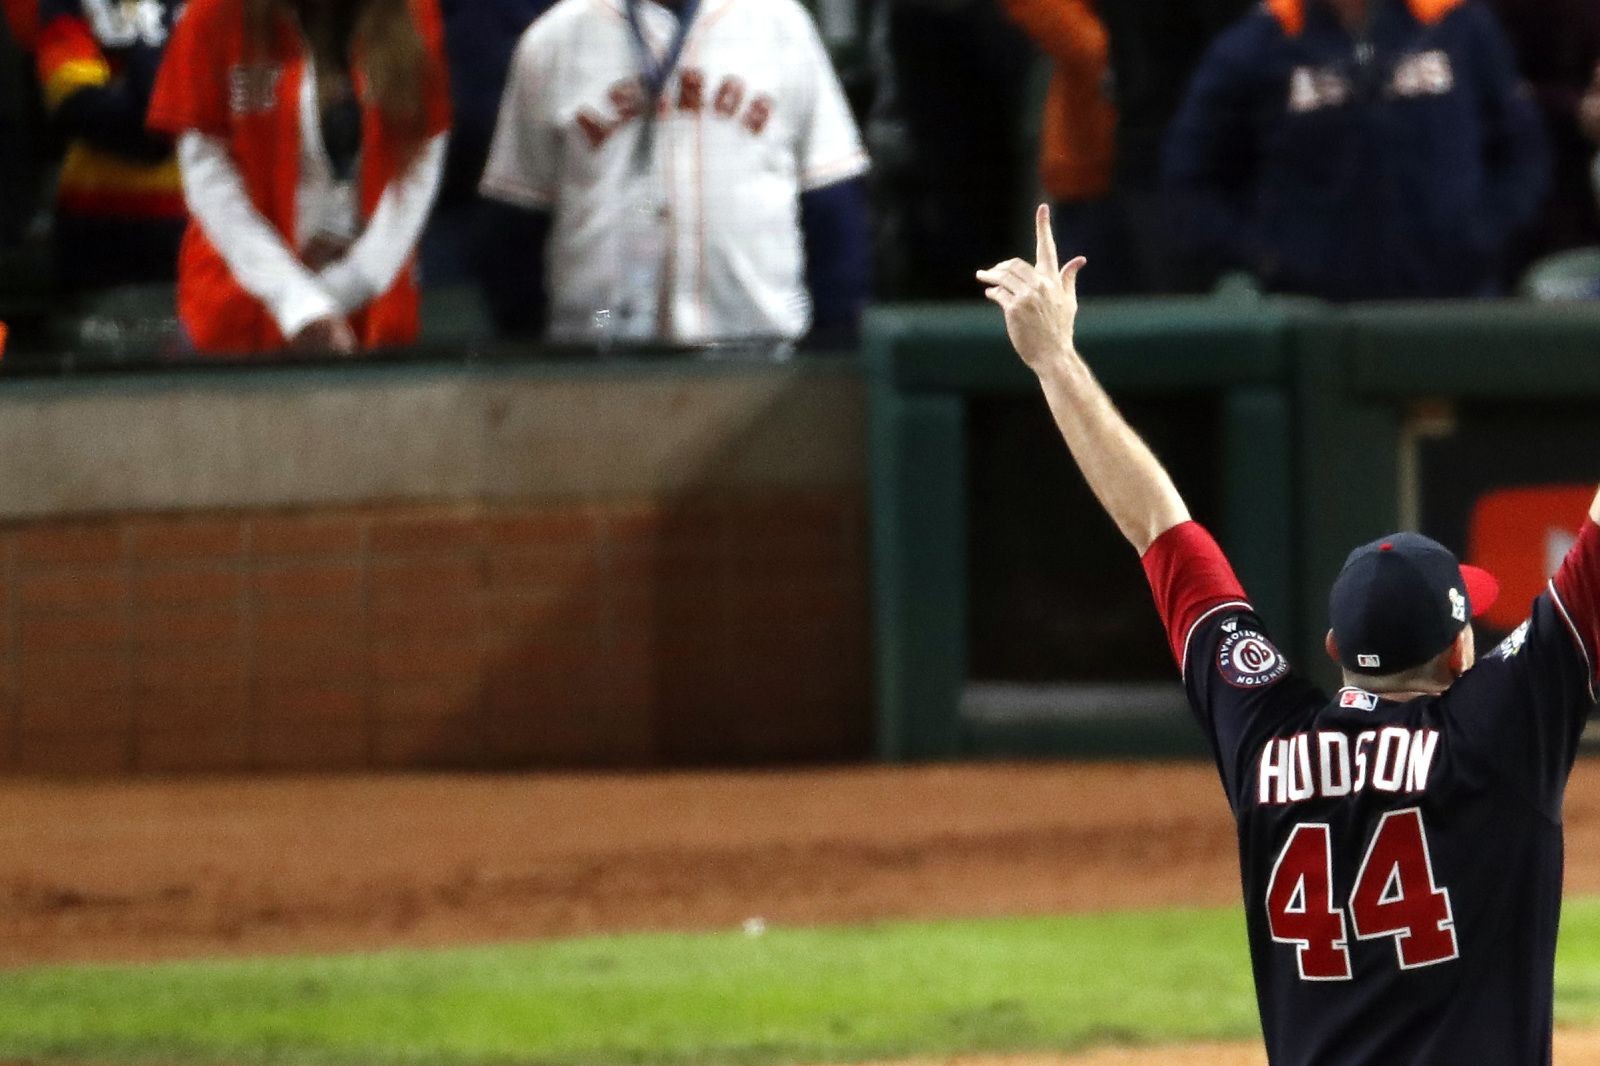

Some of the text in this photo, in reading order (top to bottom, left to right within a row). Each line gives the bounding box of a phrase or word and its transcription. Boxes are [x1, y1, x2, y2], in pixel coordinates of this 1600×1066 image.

[574, 66, 775, 148] ASROS
[1220, 629, 1265, 666] NATIONALS
[1236, 653, 1288, 685] HINGTON
[1257, 725, 1440, 804] HUDSON
[1264, 806, 1460, 981] 44
